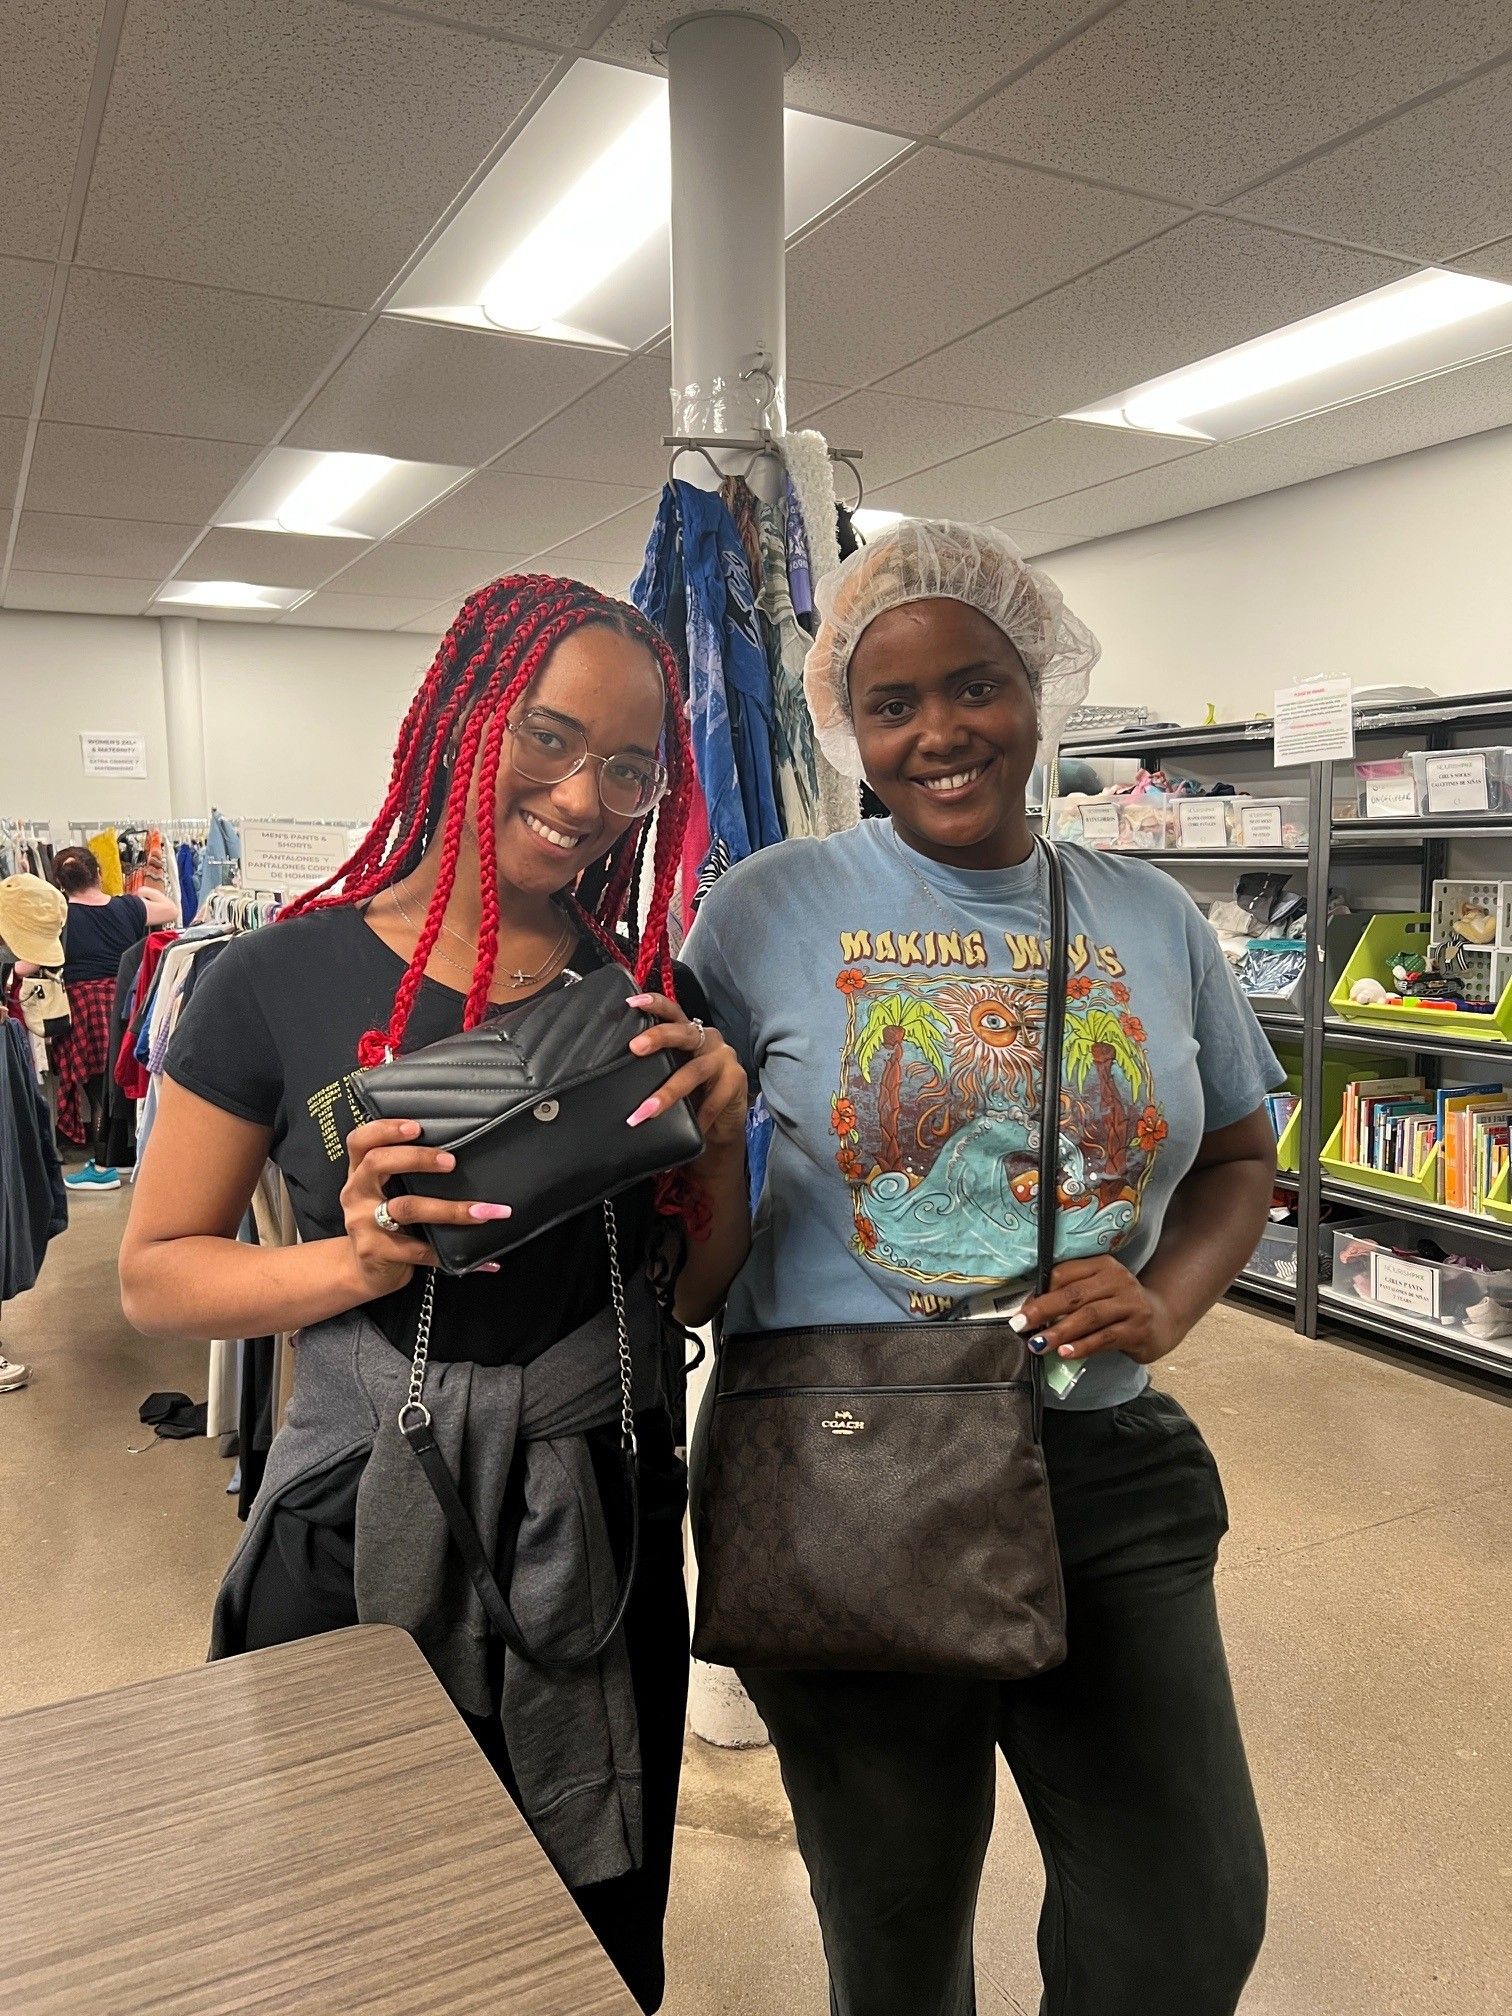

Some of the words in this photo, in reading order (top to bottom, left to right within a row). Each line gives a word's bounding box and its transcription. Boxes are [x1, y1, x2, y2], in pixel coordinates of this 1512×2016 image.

[261, 832, 288, 840] MEN'S
[290, 833, 320, 841] PANTS
[277, 841, 313, 850] SHORTS
[262, 853, 320, 863] PANTALONES
[247, 861, 307, 871] PANTALONES
[307, 864, 339, 873] CORTO
[270, 871, 283, 879] DE
[839, 928, 989, 970] MAKING
[1004, 932, 1127, 979] WVS
[1403, 1282, 1424, 1292] PANTS
[821, 1420, 865, 1430] COACH
